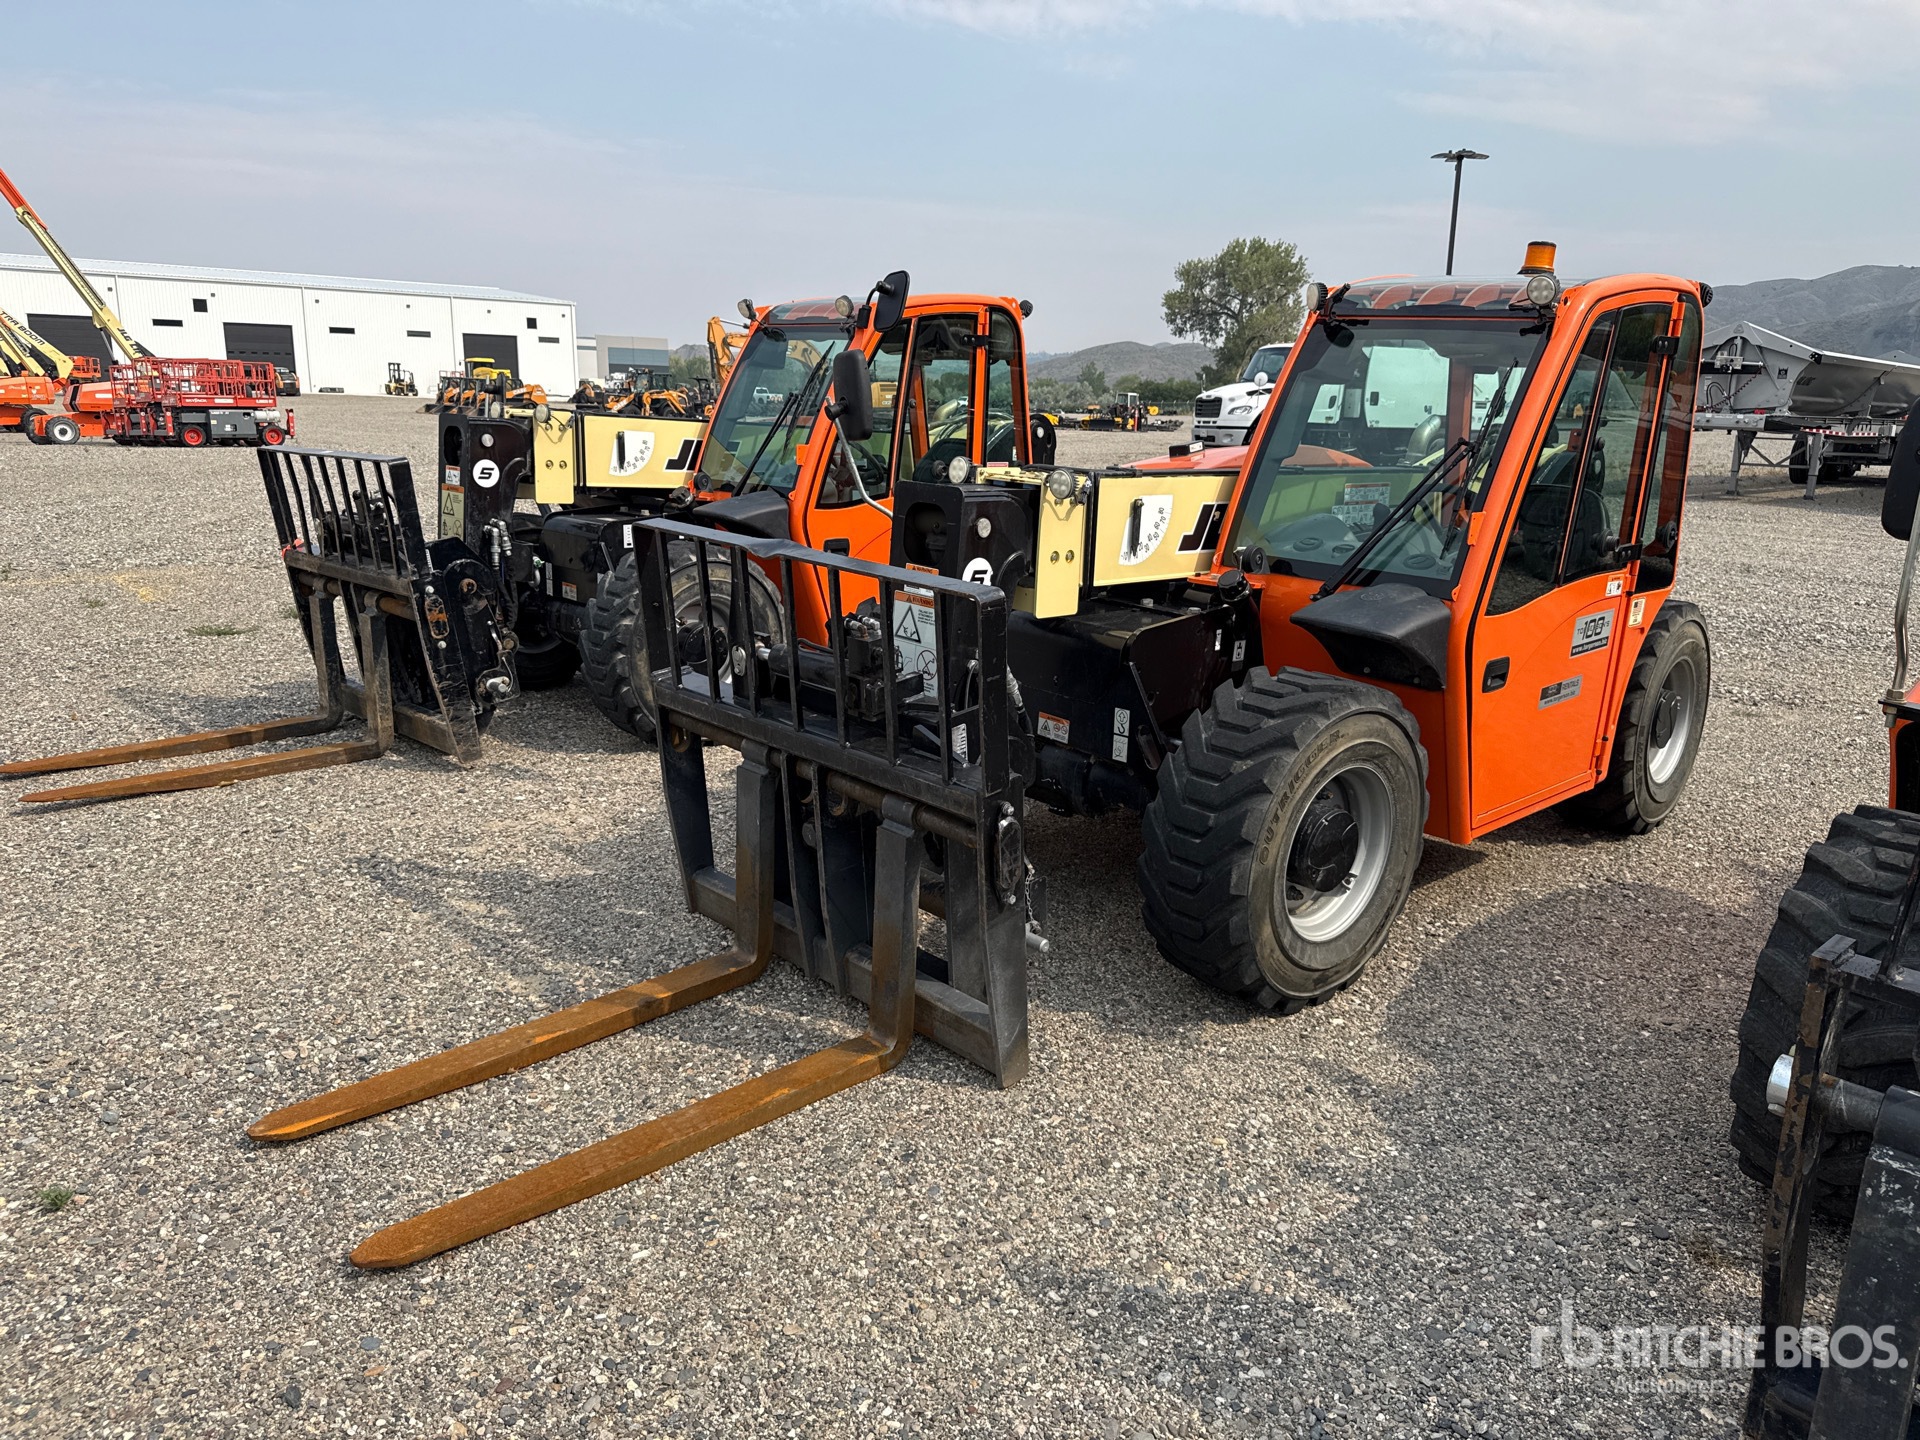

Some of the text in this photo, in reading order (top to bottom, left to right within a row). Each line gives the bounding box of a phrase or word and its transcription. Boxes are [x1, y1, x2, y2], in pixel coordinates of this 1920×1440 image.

[17, 325, 46, 346] BOOM
[117, 327, 133, 341] JLG
[1159, 516, 1167, 524] 70
[1153, 521, 1161, 530] 60
[1147, 533, 1153, 542] 40
[1152, 531, 1160, 541] 50
[911, 595, 934, 607] WARNING
